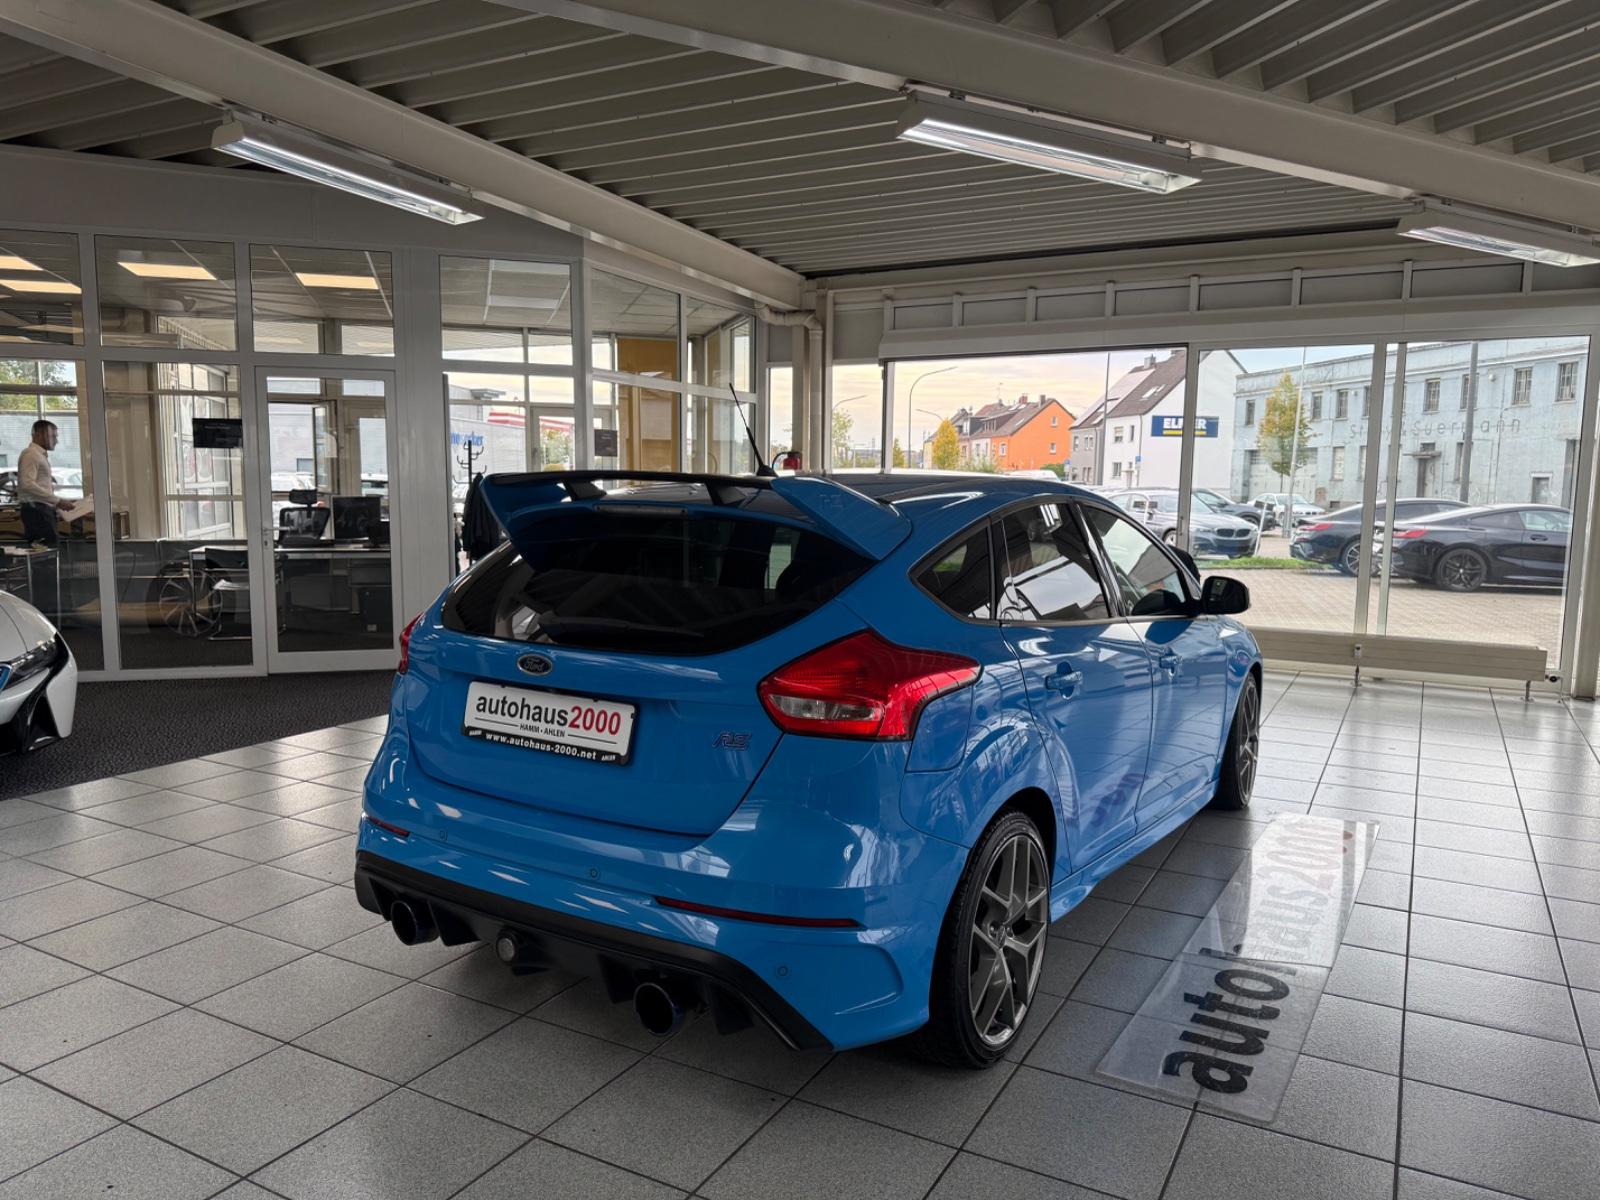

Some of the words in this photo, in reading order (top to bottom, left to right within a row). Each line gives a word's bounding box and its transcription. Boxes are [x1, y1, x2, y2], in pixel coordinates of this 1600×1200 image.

[1412, 419, 1521, 436] Suerann
[475, 695, 622, 736] autohaus2000
[544, 727, 566, 738] AHLEN
[485, 732, 597, 760] www.autohaus-2000.net
